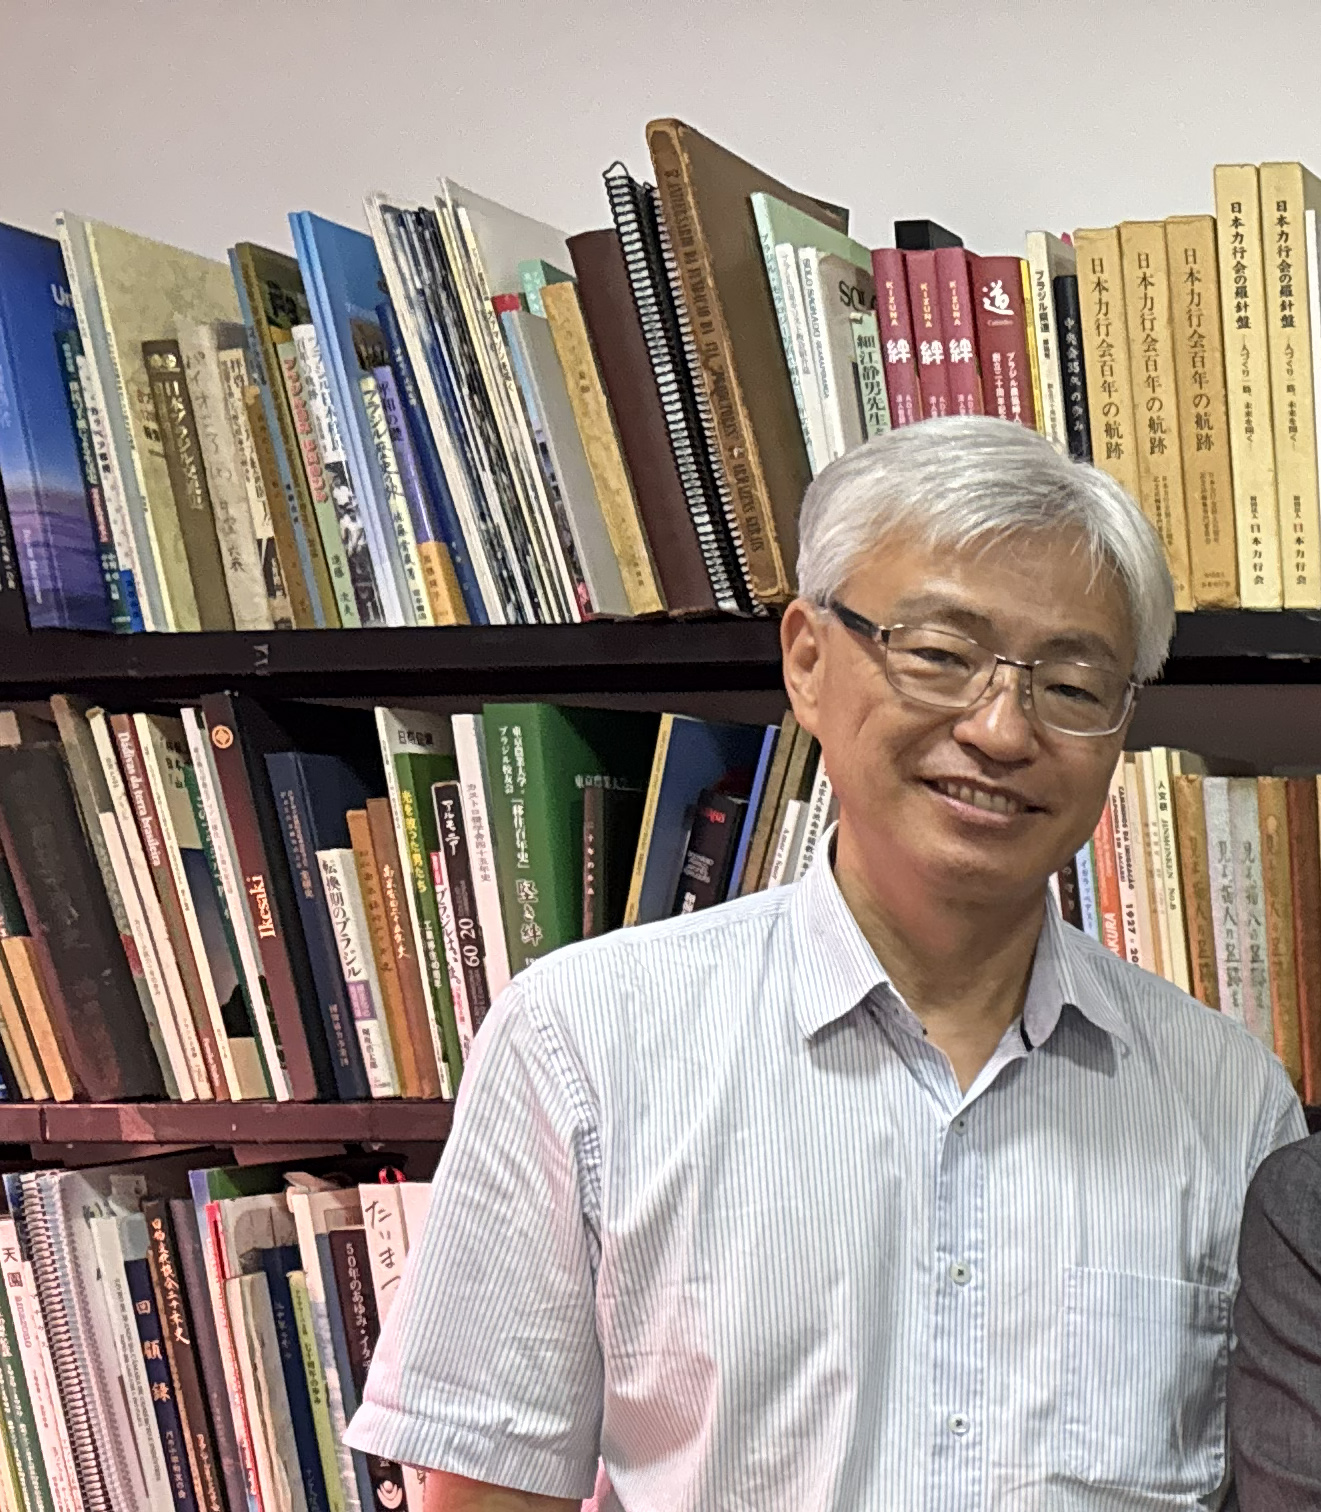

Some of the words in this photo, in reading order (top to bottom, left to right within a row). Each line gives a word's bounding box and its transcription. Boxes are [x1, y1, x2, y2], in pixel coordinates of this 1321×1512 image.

[1230, 201, 1252, 330] 日本力行会の羅針盤
[1275, 199, 1297, 328] 日本力行会の羅針盤
[886, 281, 898, 328] KIZUNA
[920, 283, 932, 328] KIZUNA
[949, 280, 962, 326] KIZUNA
[981, 279, 1015, 315] 道
[887, 338, 911, 364] 絆
[920, 340, 945, 365] 絆
[949, 338, 973, 364] 絆
[1090, 256, 1124, 460] 日本力行会百年の航跡
[1136, 251, 1168, 455] 日本力行会百年の航跡
[1183, 247, 1215, 452] 日本力行会百年の航跡
[246, 874, 277, 939] Ikesaki
[322, 858, 362, 979] 転換期のブラジル
[1125, 903, 1137, 935] 1927
